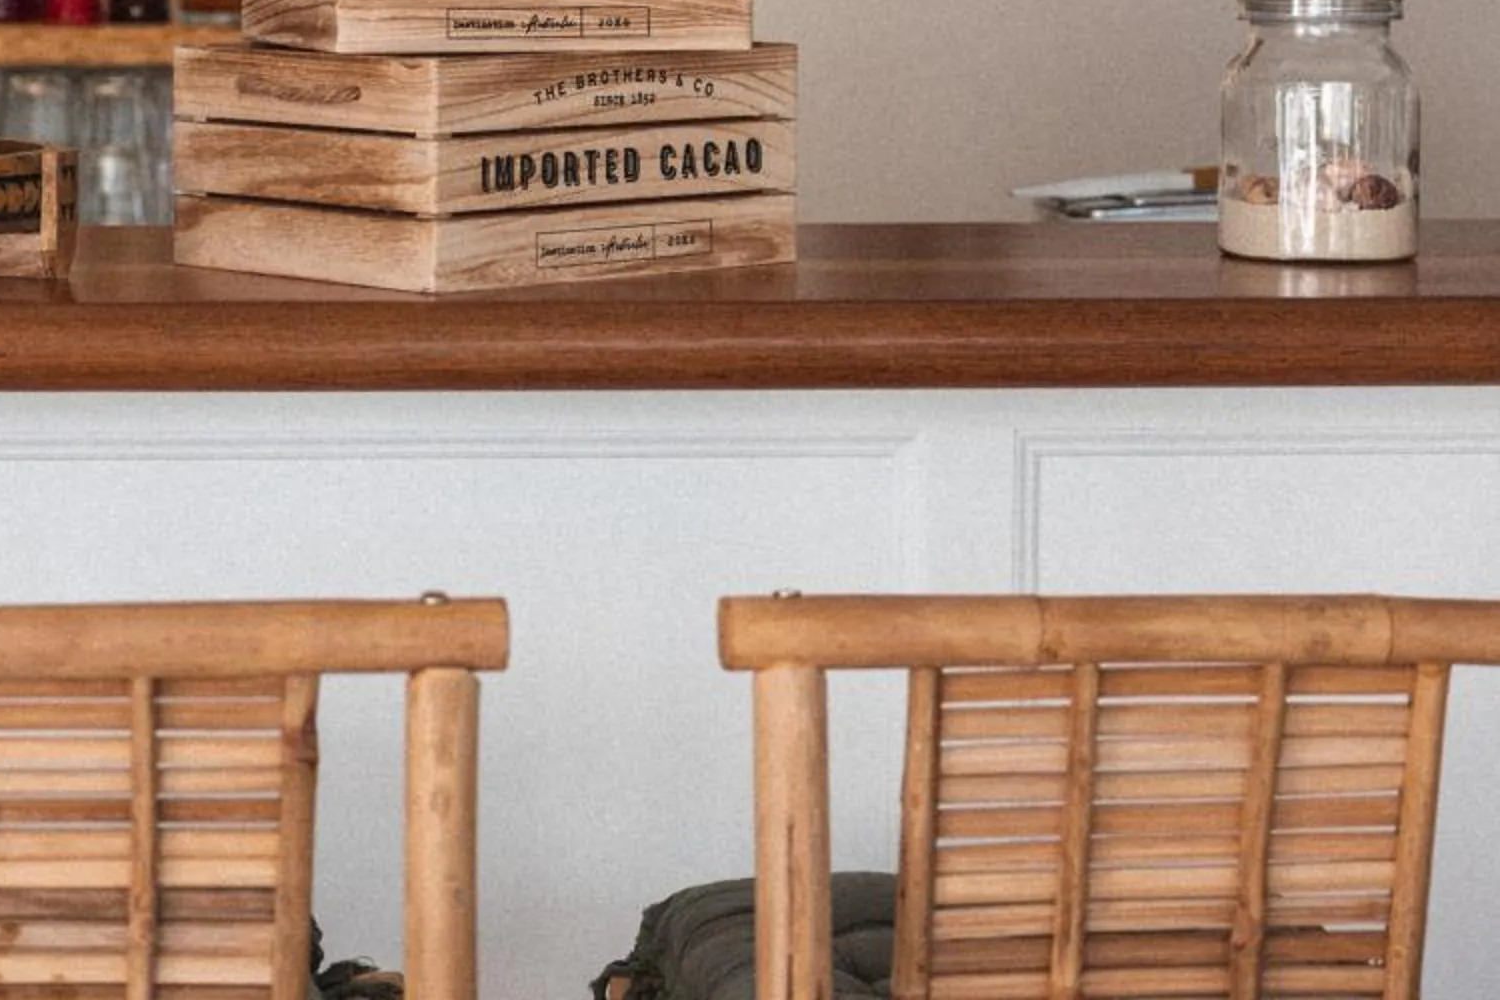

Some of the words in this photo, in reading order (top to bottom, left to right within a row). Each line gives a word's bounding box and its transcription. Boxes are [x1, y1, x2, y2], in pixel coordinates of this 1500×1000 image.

[533, 80, 567, 105] THE
[575, 68, 668, 90] BROTHERS
[693, 77, 715, 98] CO
[480, 147, 641, 194] IMPORTED
[659, 137, 762, 181] CACAO
